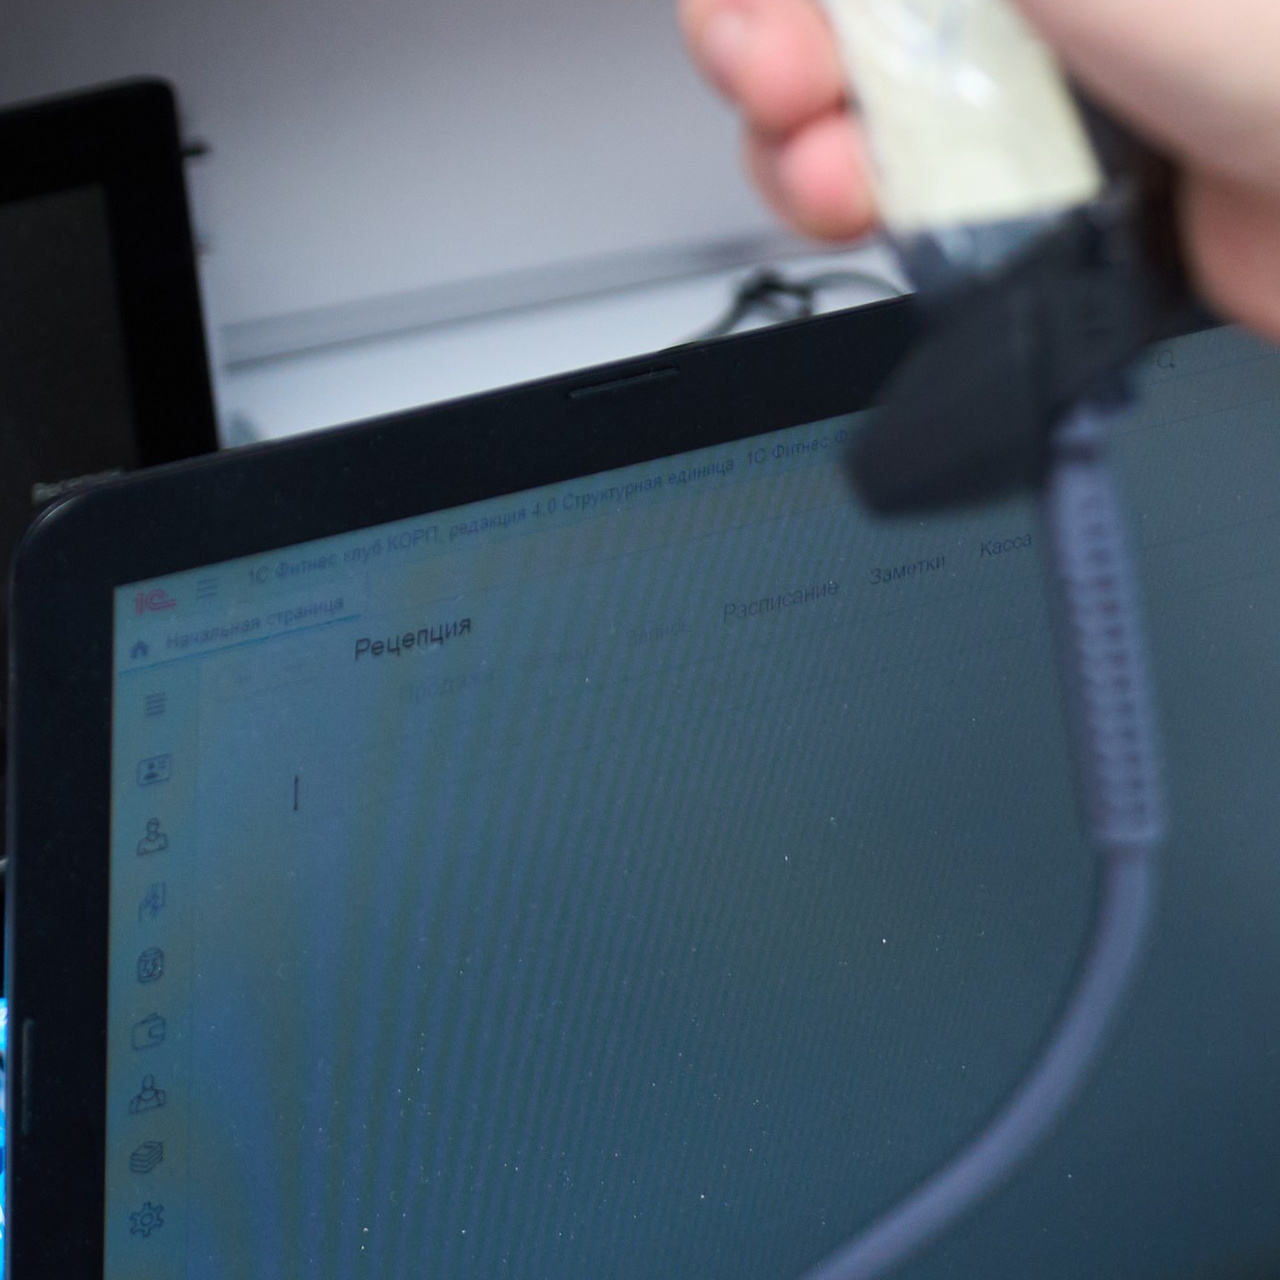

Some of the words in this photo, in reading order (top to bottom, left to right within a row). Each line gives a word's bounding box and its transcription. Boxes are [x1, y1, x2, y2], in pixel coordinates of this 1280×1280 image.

[448, 506, 528, 543] редакция
[561, 473, 663, 515] Структурная
[979, 532, 1033, 559] Касса
[870, 553, 946, 587] Заметки
[723, 580, 840, 625] Расписание
[353, 615, 473, 663] Рецепция
